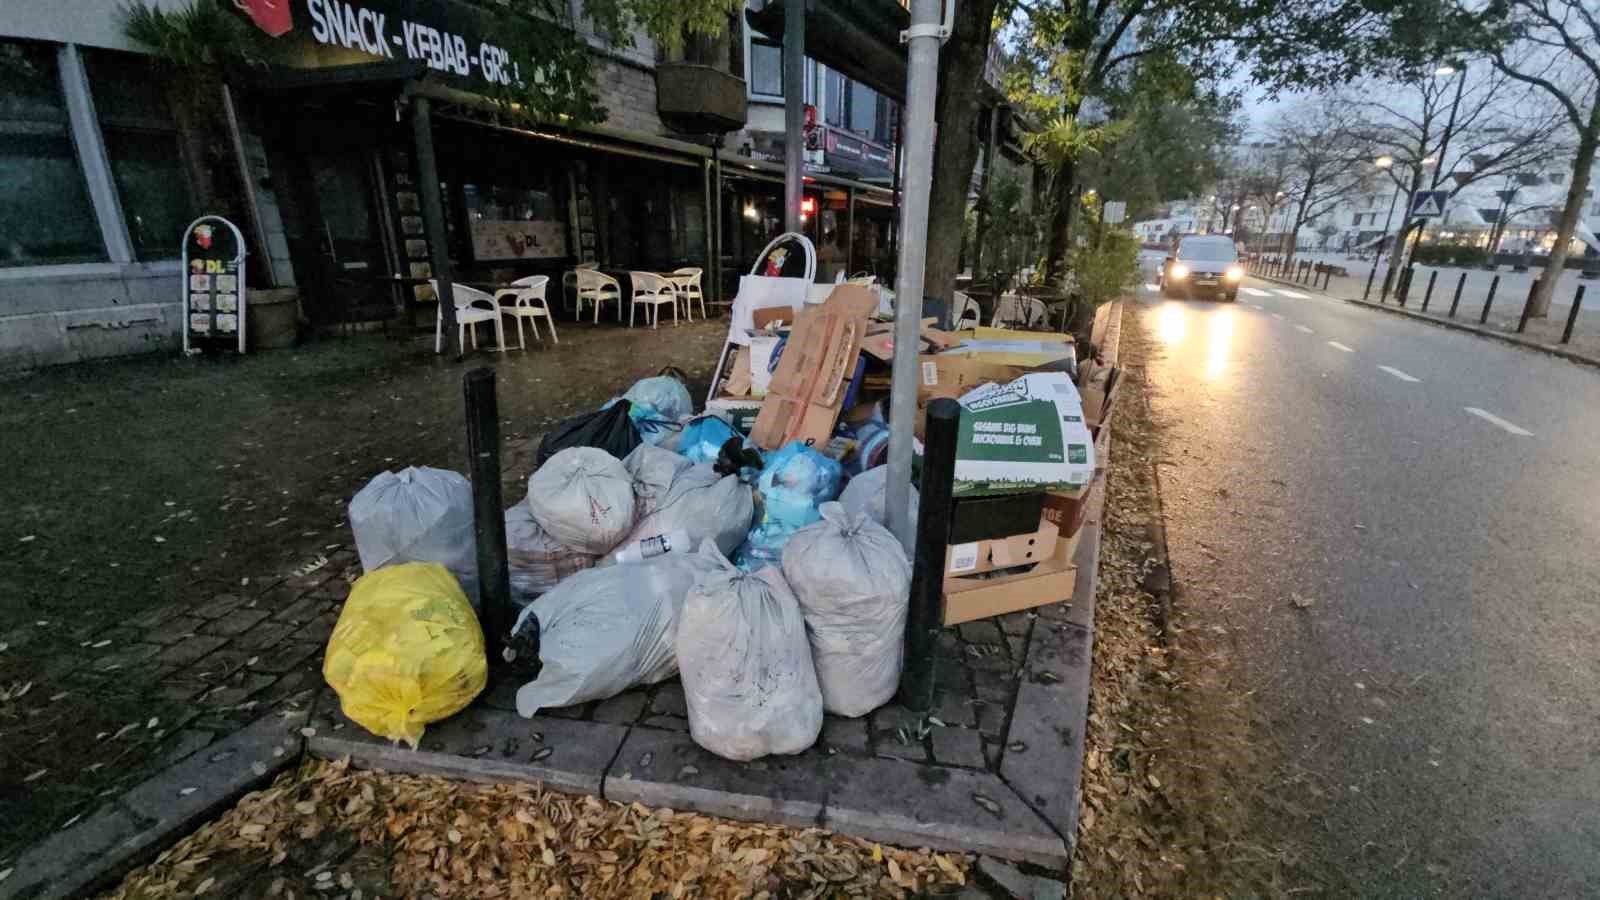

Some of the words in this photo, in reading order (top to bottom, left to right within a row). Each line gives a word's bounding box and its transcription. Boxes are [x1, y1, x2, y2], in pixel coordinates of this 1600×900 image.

[308, 0, 393, 58] SNACK
[402, 20, 470, 77] KEBAB
[206, 260, 226, 274] DL
